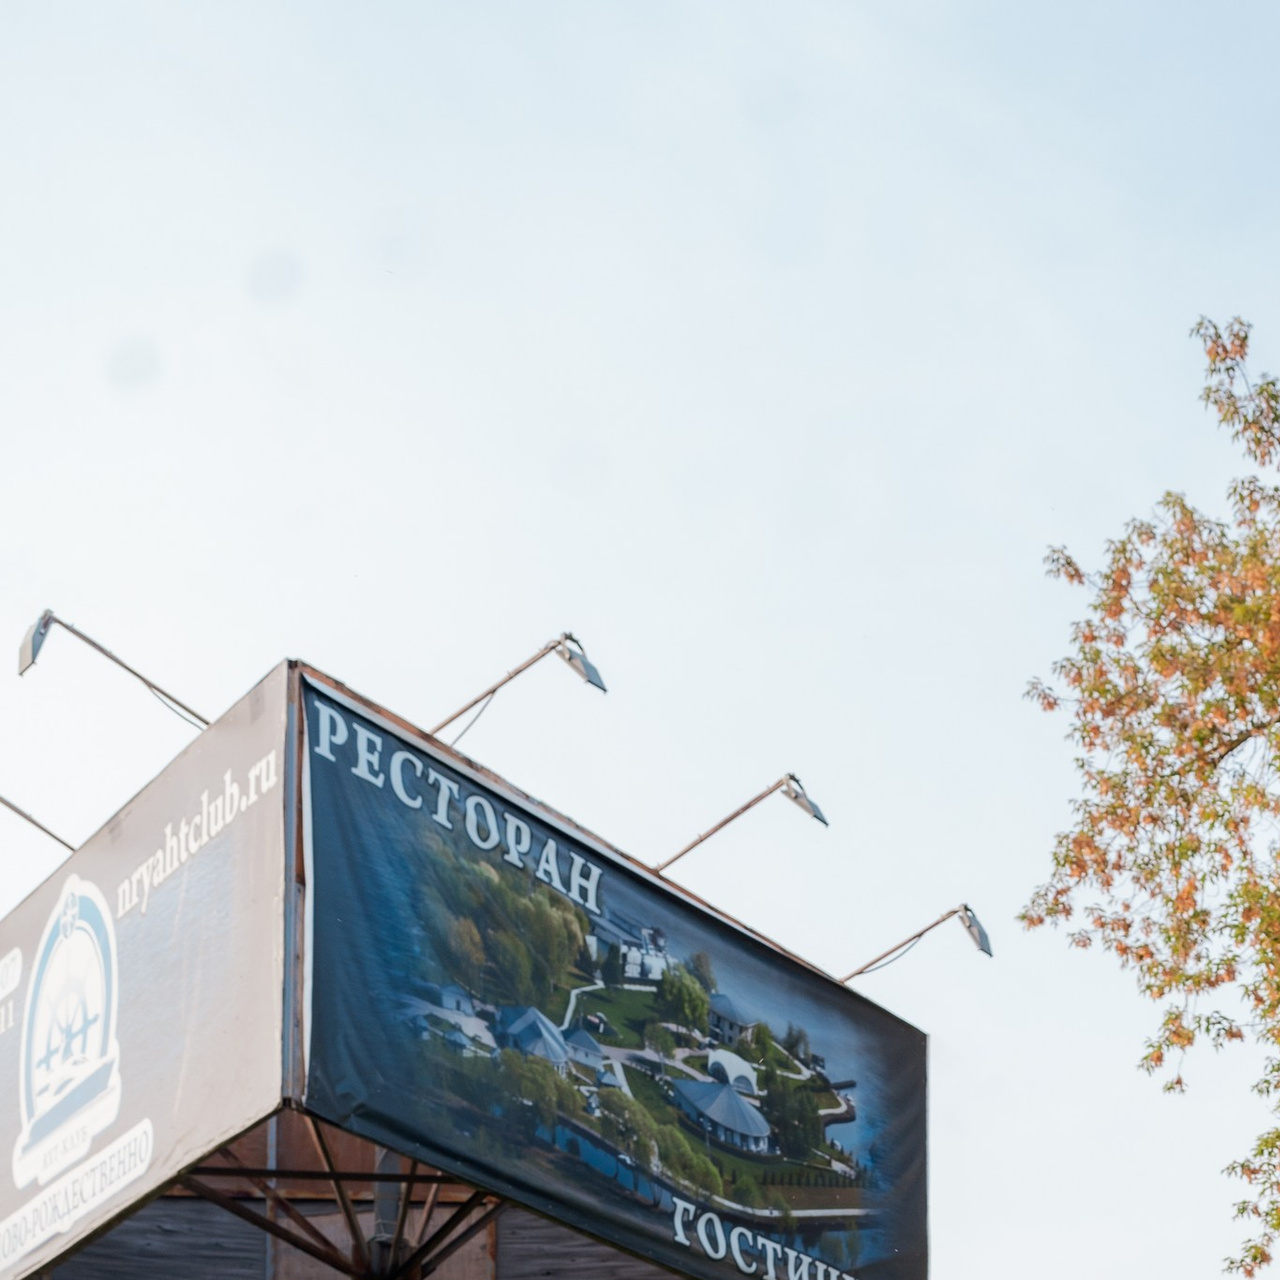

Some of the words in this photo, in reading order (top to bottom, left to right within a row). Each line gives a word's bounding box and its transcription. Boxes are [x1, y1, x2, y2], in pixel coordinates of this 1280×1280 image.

[116, 749, 278, 919] nryahtclub.ru
[314, 700, 603, 915] РЕСТОРАН
[0, 1129, 150, 1260] ОВО-РОЖДЕСТВЕННО
